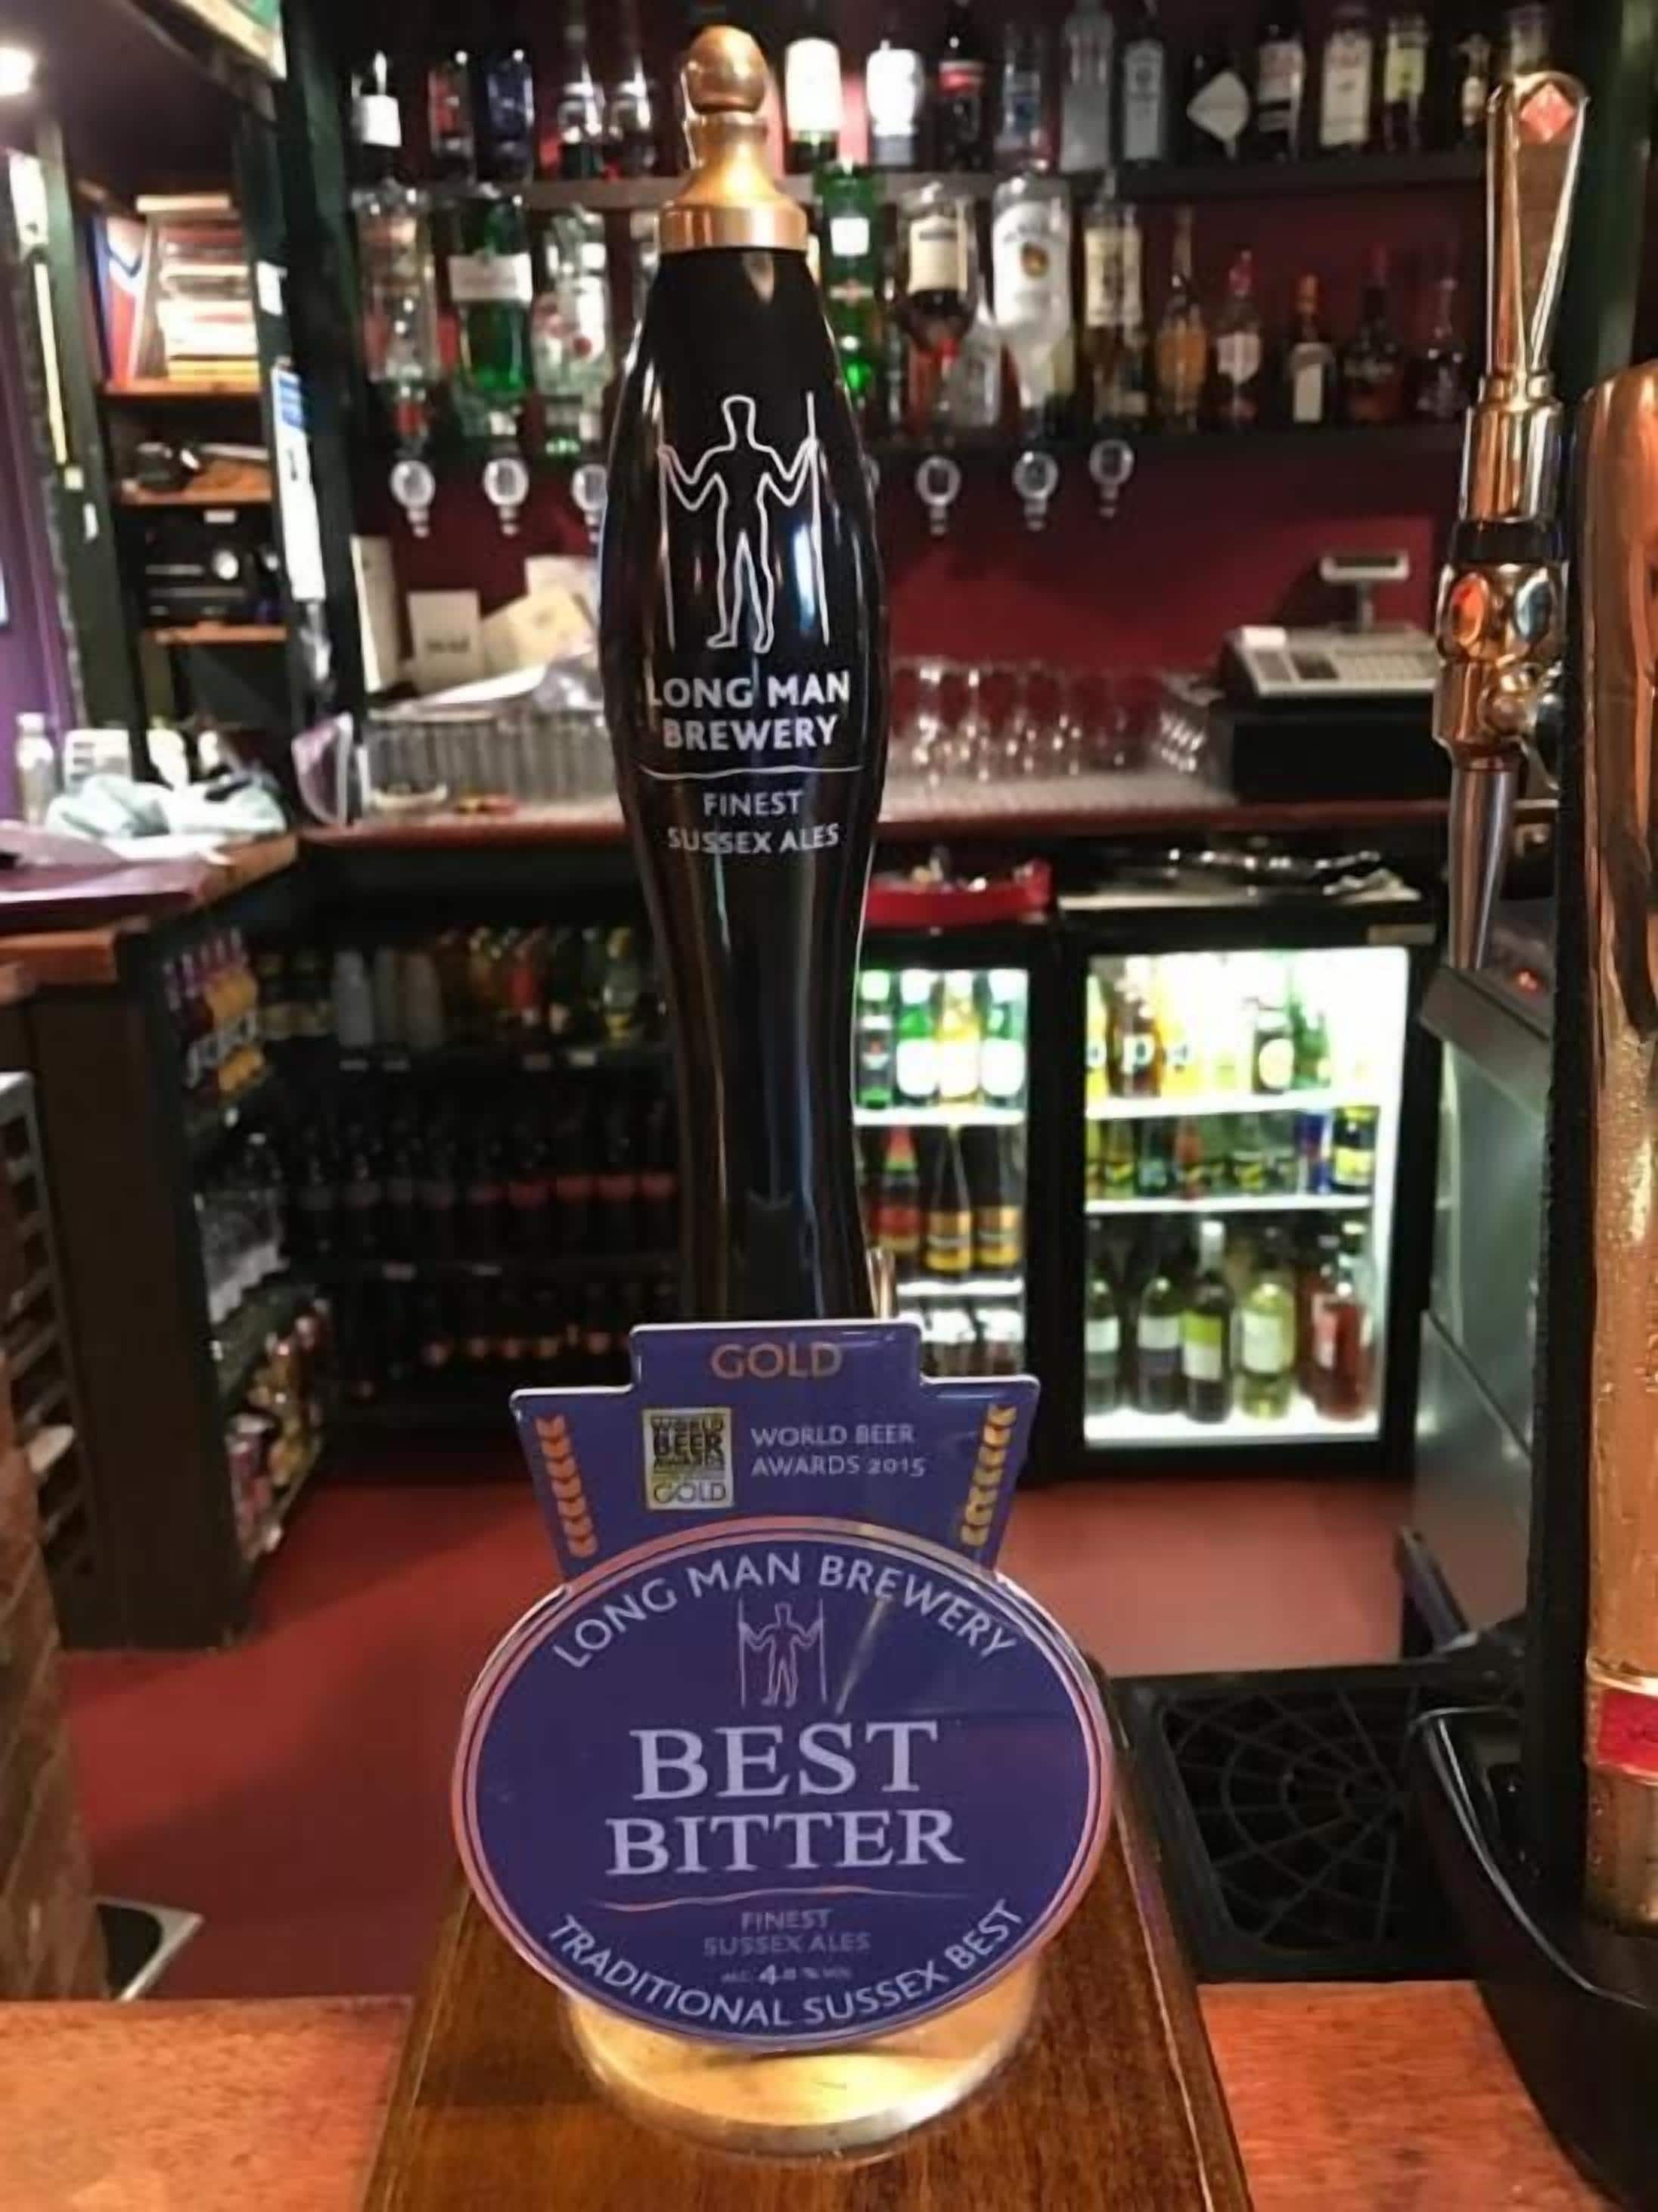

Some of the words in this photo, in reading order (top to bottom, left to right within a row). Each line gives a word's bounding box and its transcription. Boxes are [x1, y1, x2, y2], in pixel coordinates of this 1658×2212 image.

[648, 677, 753, 709] LONG
[767, 670, 849, 704] MAN
[663, 715, 838, 751] BREWERY
[703, 790, 803, 816] FINEST
[668, 826, 772, 854] SUSSEX
[780, 823, 839, 851] ALES
[711, 1342, 843, 1378] GOLD
[751, 1426, 848, 1448] WORLD
[855, 1424, 914, 1444] BEER
[751, 1456, 860, 1477] AWARDS
[868, 1457, 927, 1477] 2015
[654, 1483, 726, 1504] GOLD
[553, 1577, 678, 1669] LONG
[688, 1551, 800, 1600] MAN
[819, 1555, 1017, 1660] BREWERY
[630, 1721, 939, 1802] BEST
[606, 1809, 964, 1876] BITTER
[741, 1909, 833, 1931] FINEST
[703, 1936, 802, 1956] SUSSEX
[808, 1931, 871, 1953] ALES
[548, 1914, 792, 2028] TRADITIONAL
[802, 1962, 949, 2026] SUSSEX
[945, 1899, 1024, 1970] BEST
